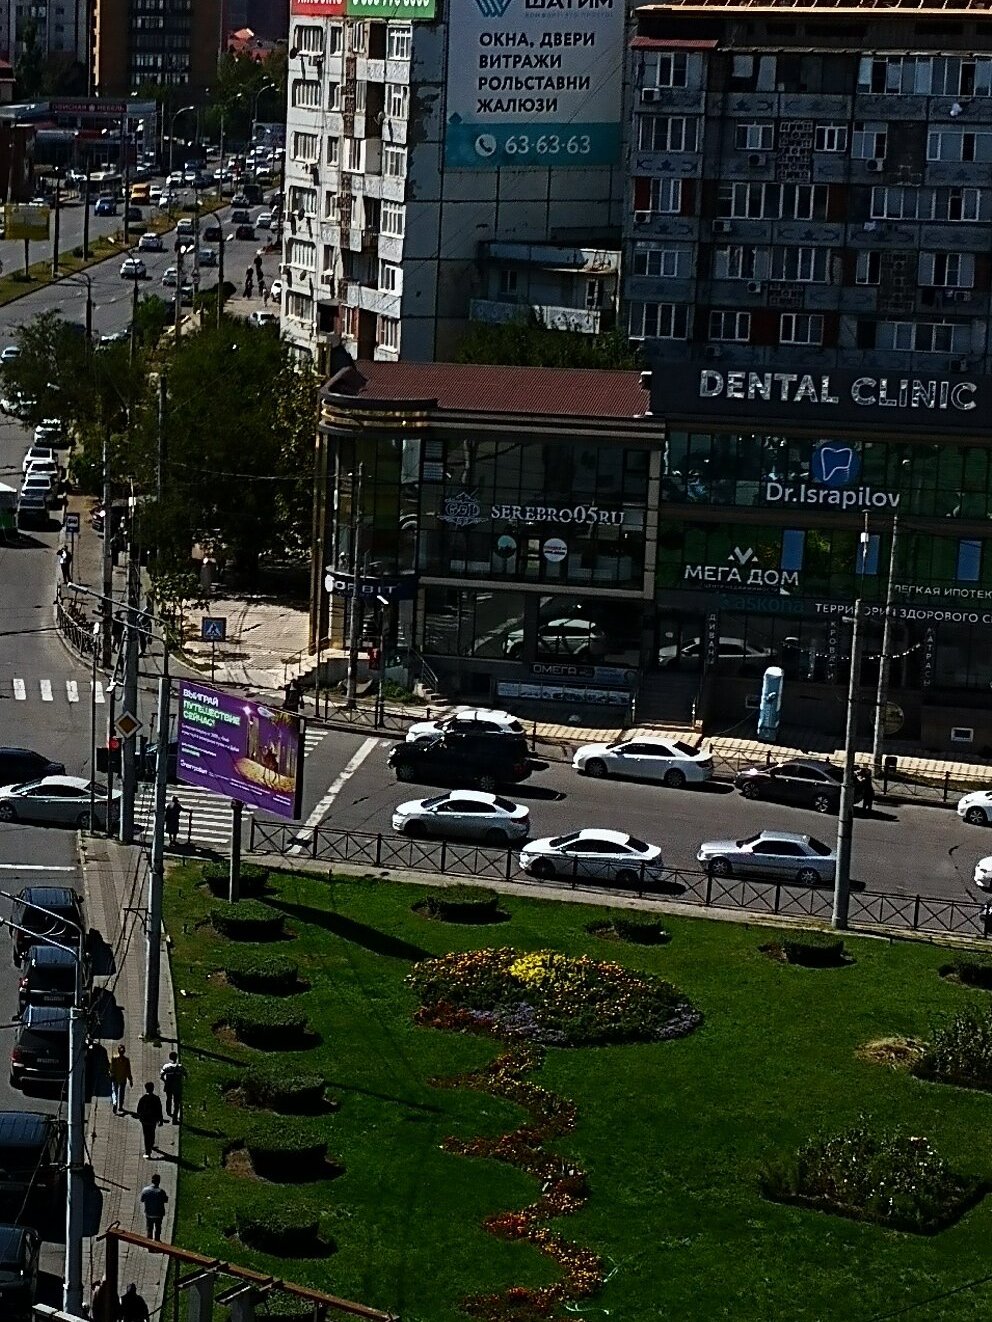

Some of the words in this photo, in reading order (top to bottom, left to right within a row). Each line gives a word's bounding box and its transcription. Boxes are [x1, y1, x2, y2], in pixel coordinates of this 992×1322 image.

[479, 32, 534, 48] ОКНА,
[539, 32, 595, 48] ДВЕРИ
[479, 54, 562, 69] ВИТРАЖИ
[477, 76, 591, 91] РОЛЬСТАВНИ
[476, 98, 558, 113] ЖАЛЮЗИ
[698, 369, 840, 405] DENTAL
[851, 376, 978, 411] CLINIC
[766, 482, 901, 510] Dr.Israpilov
[684, 564, 743, 583] МЕГА
[746, 568, 800, 586] ДОМ
[735, 596, 805, 613] askona
[815, 603, 897, 618] ТЕРРИОРИ
[899, 608, 979, 624] ЗДОРОВОГО
[532, 664, 578, 675] ОМЕГА
